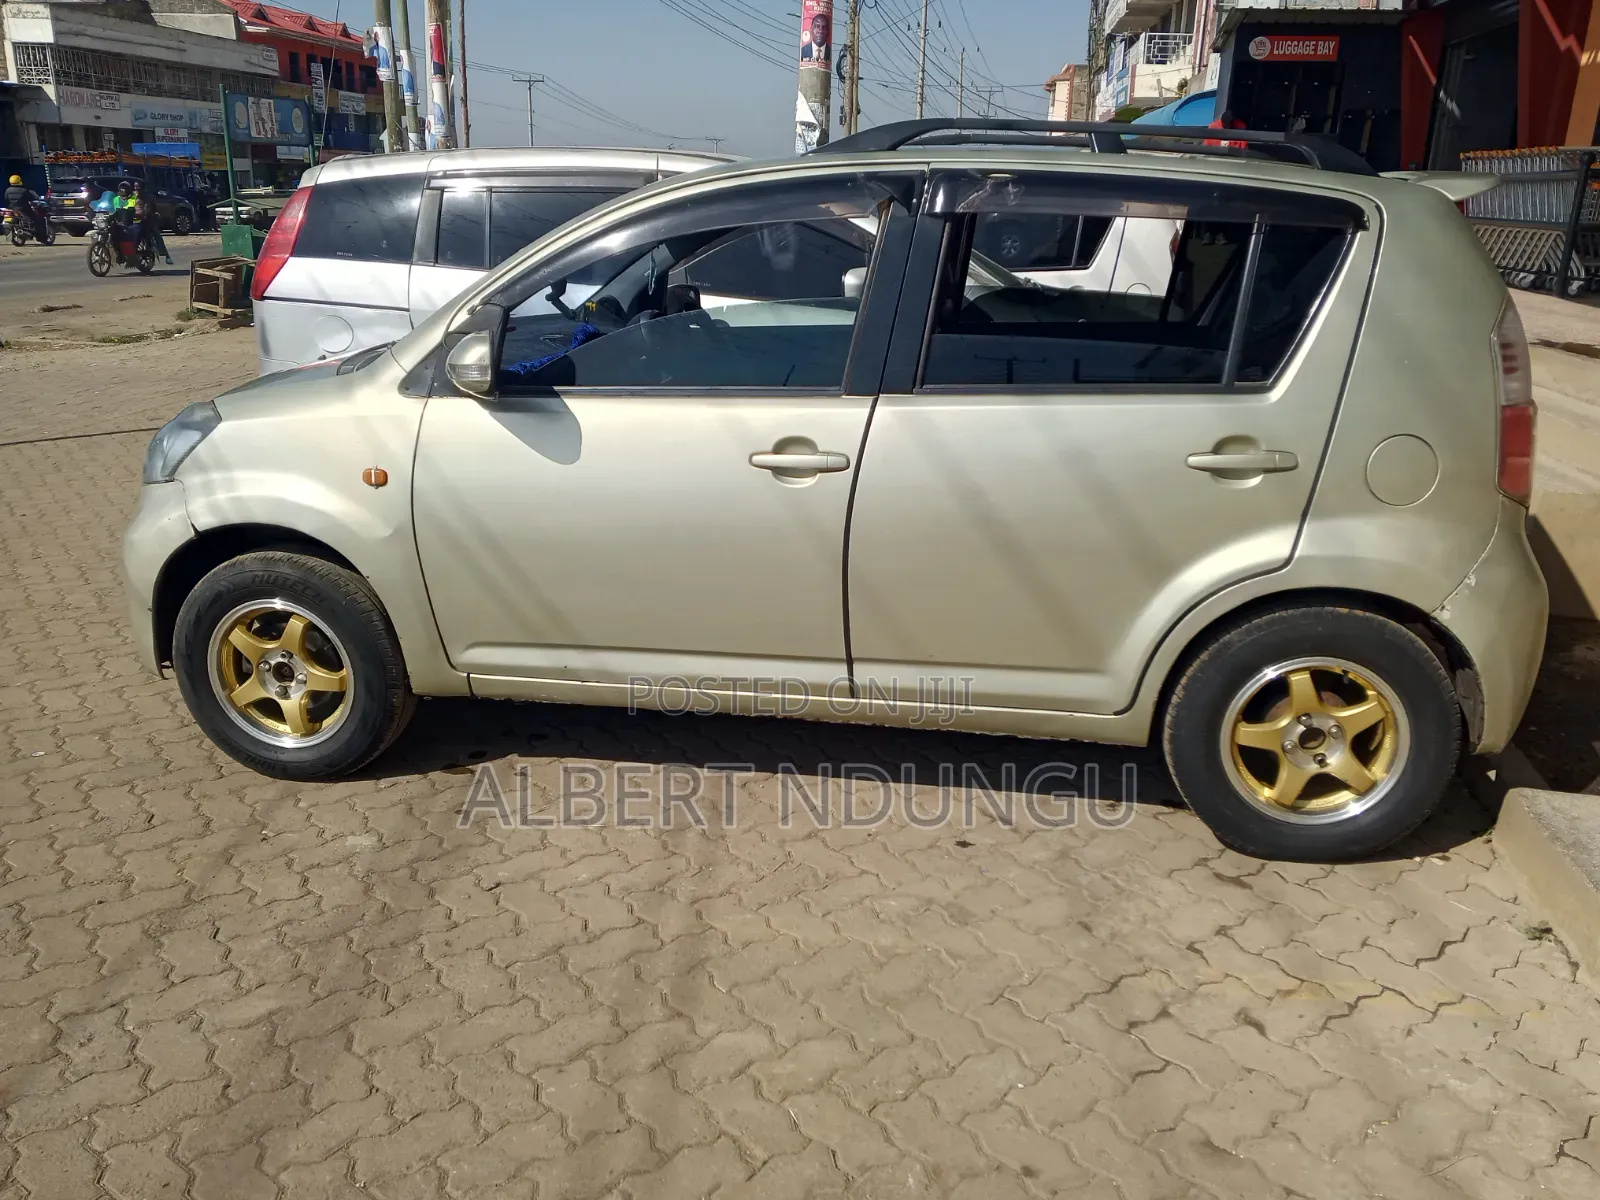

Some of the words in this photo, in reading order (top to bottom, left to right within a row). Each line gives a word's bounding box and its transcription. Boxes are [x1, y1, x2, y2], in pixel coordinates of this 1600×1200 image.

[1273, 41, 1315, 55] LUGGAGE
[1317, 41, 1336, 55] BAY
[60, 90, 101, 108] HARDWARE
[150, 112, 169, 121] GLORY
[169, 114, 184, 122] SHOP
[163, 128, 180, 136] GLORY
